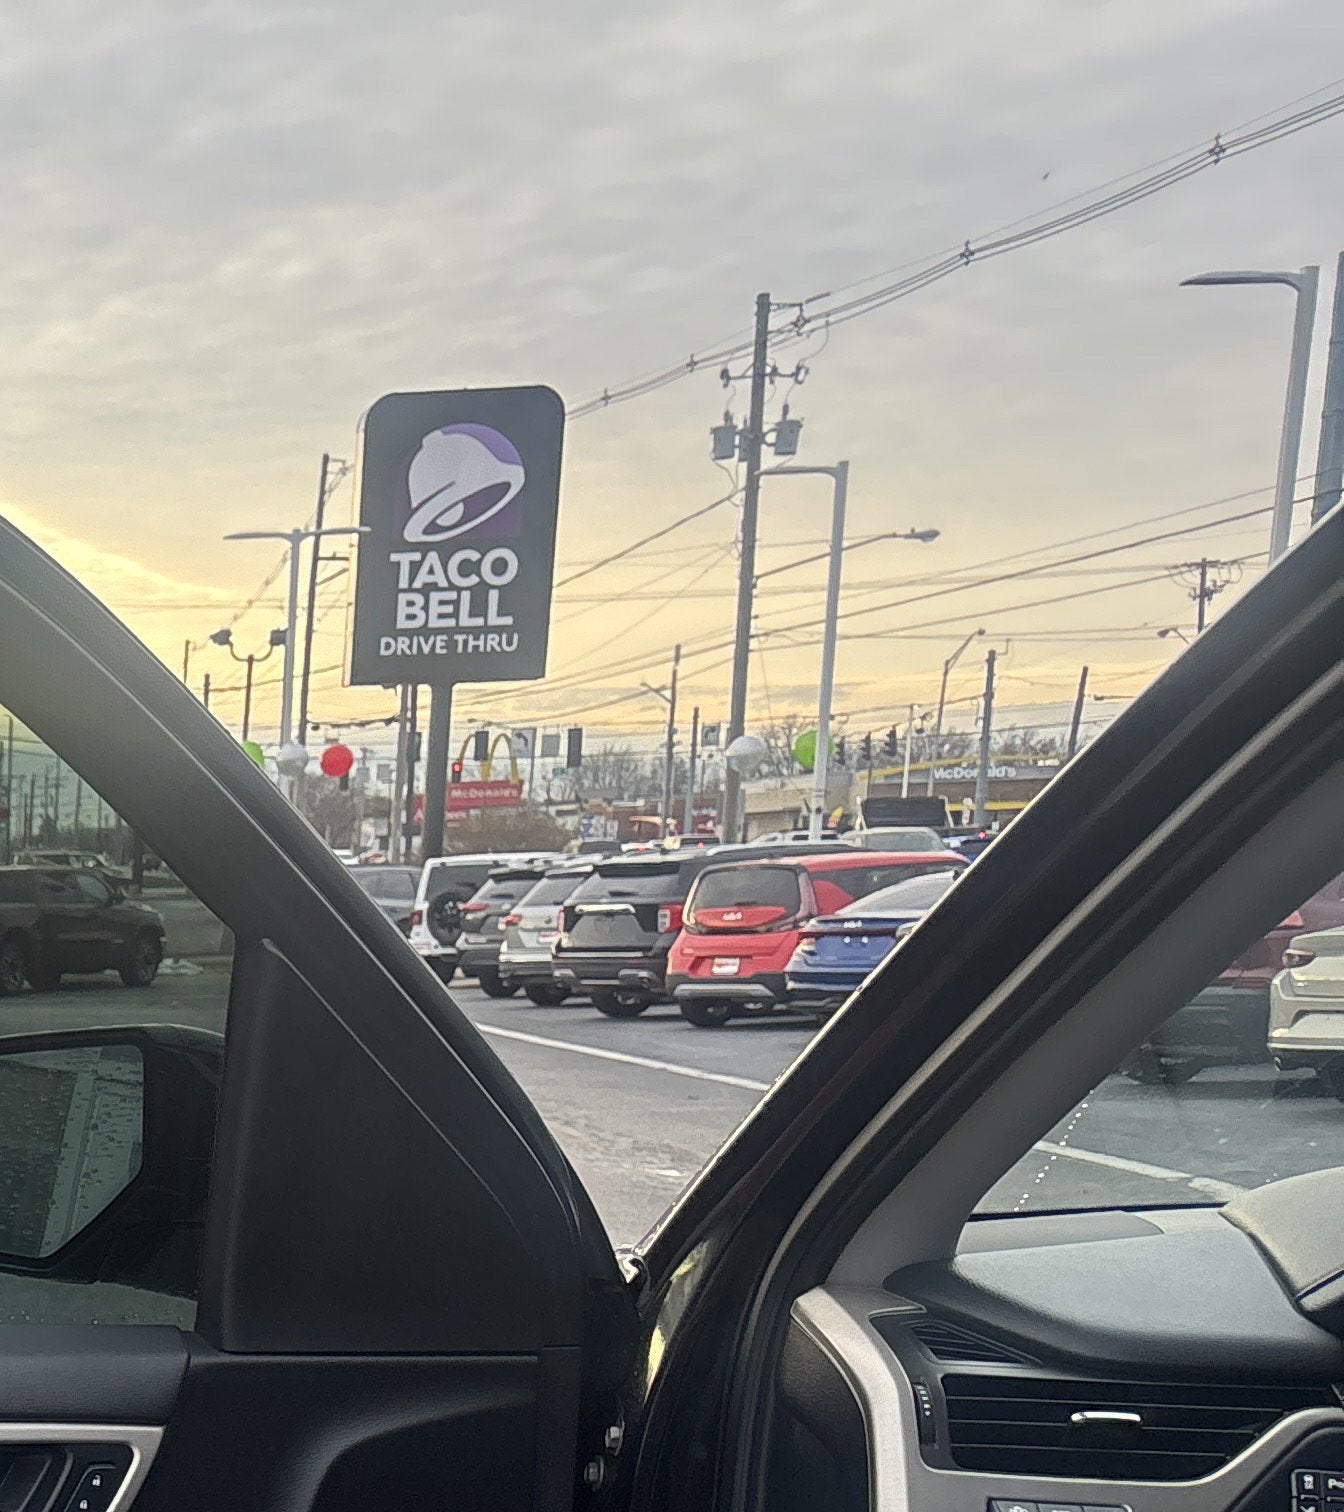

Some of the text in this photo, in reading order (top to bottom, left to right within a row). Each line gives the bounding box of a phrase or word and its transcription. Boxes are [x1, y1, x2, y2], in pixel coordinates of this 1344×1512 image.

[390, 547, 519, 589] TACO
[396, 589, 514, 629] BELL
[379, 633, 519, 656] DRIVE THRU
[450, 787, 519, 799] McDonald's
